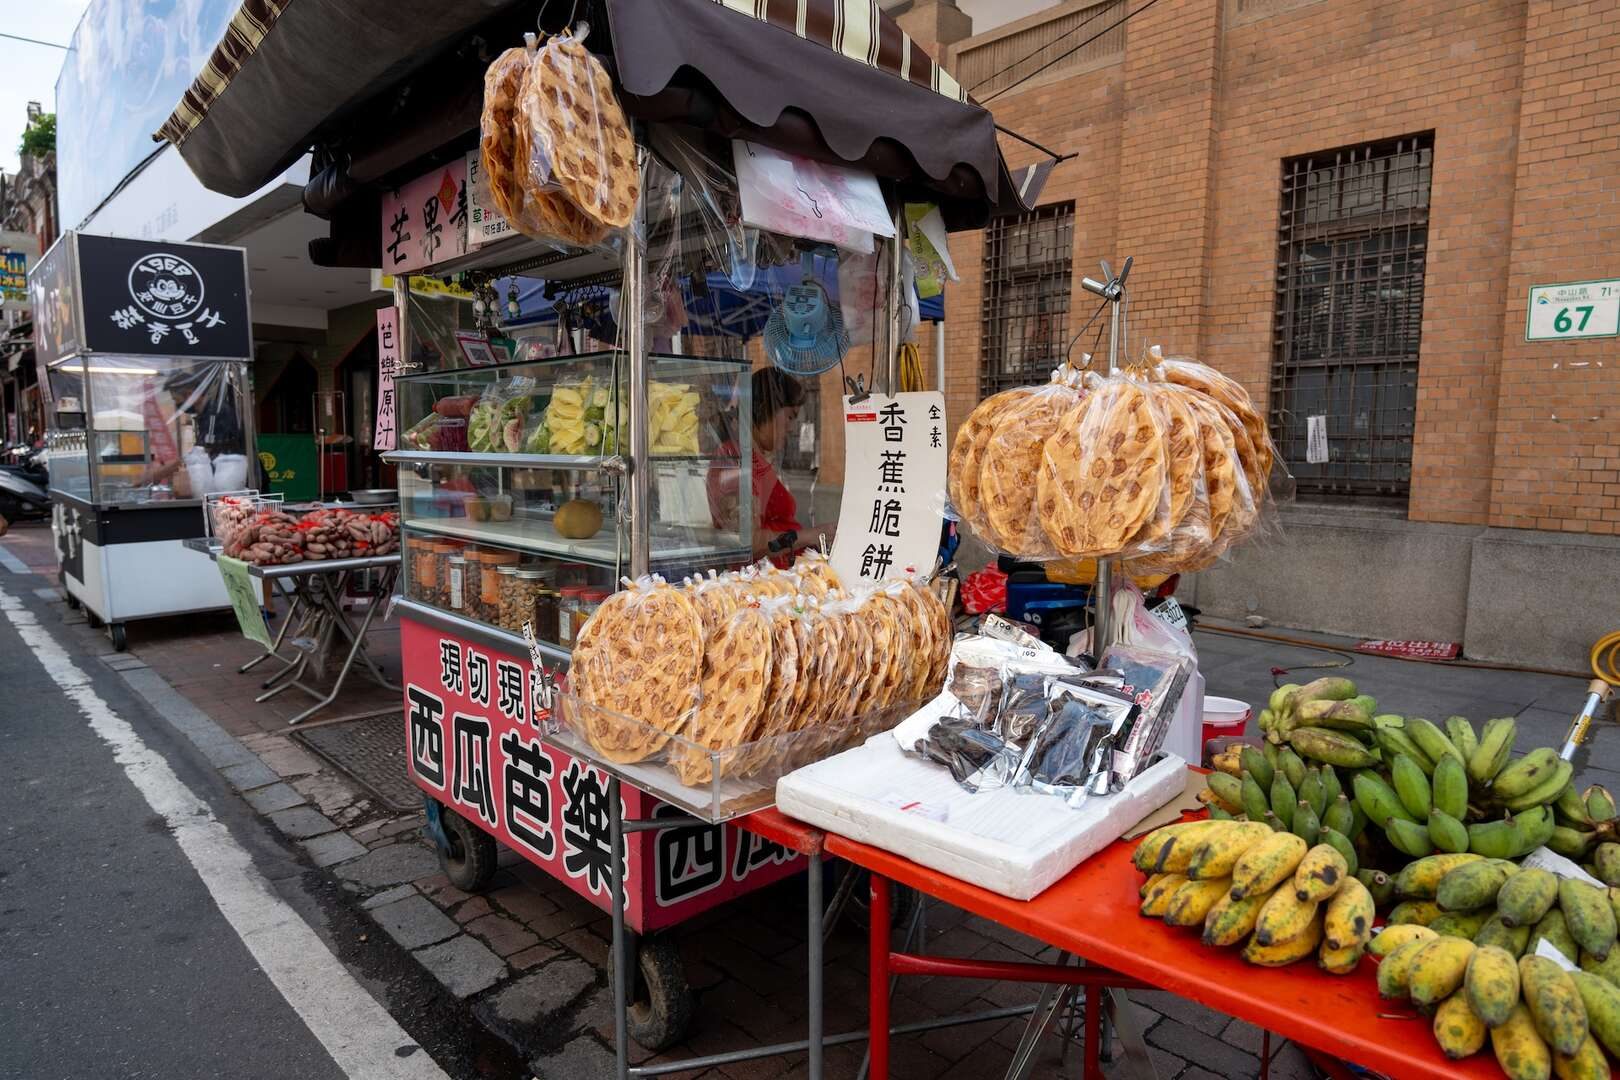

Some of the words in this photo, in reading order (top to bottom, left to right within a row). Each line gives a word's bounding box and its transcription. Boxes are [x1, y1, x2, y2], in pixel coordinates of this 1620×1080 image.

[139, 258, 193, 276] 1968
[1554, 306, 1594, 333] 67
[377, 321, 395, 447] 芭樂原汁
[928, 404, 942, 448] 全素
[859, 402, 908, 581] 香蕉脆餅
[994, 620, 1012, 631] 100
[407, 683, 629, 910] 西瓜芭樂
